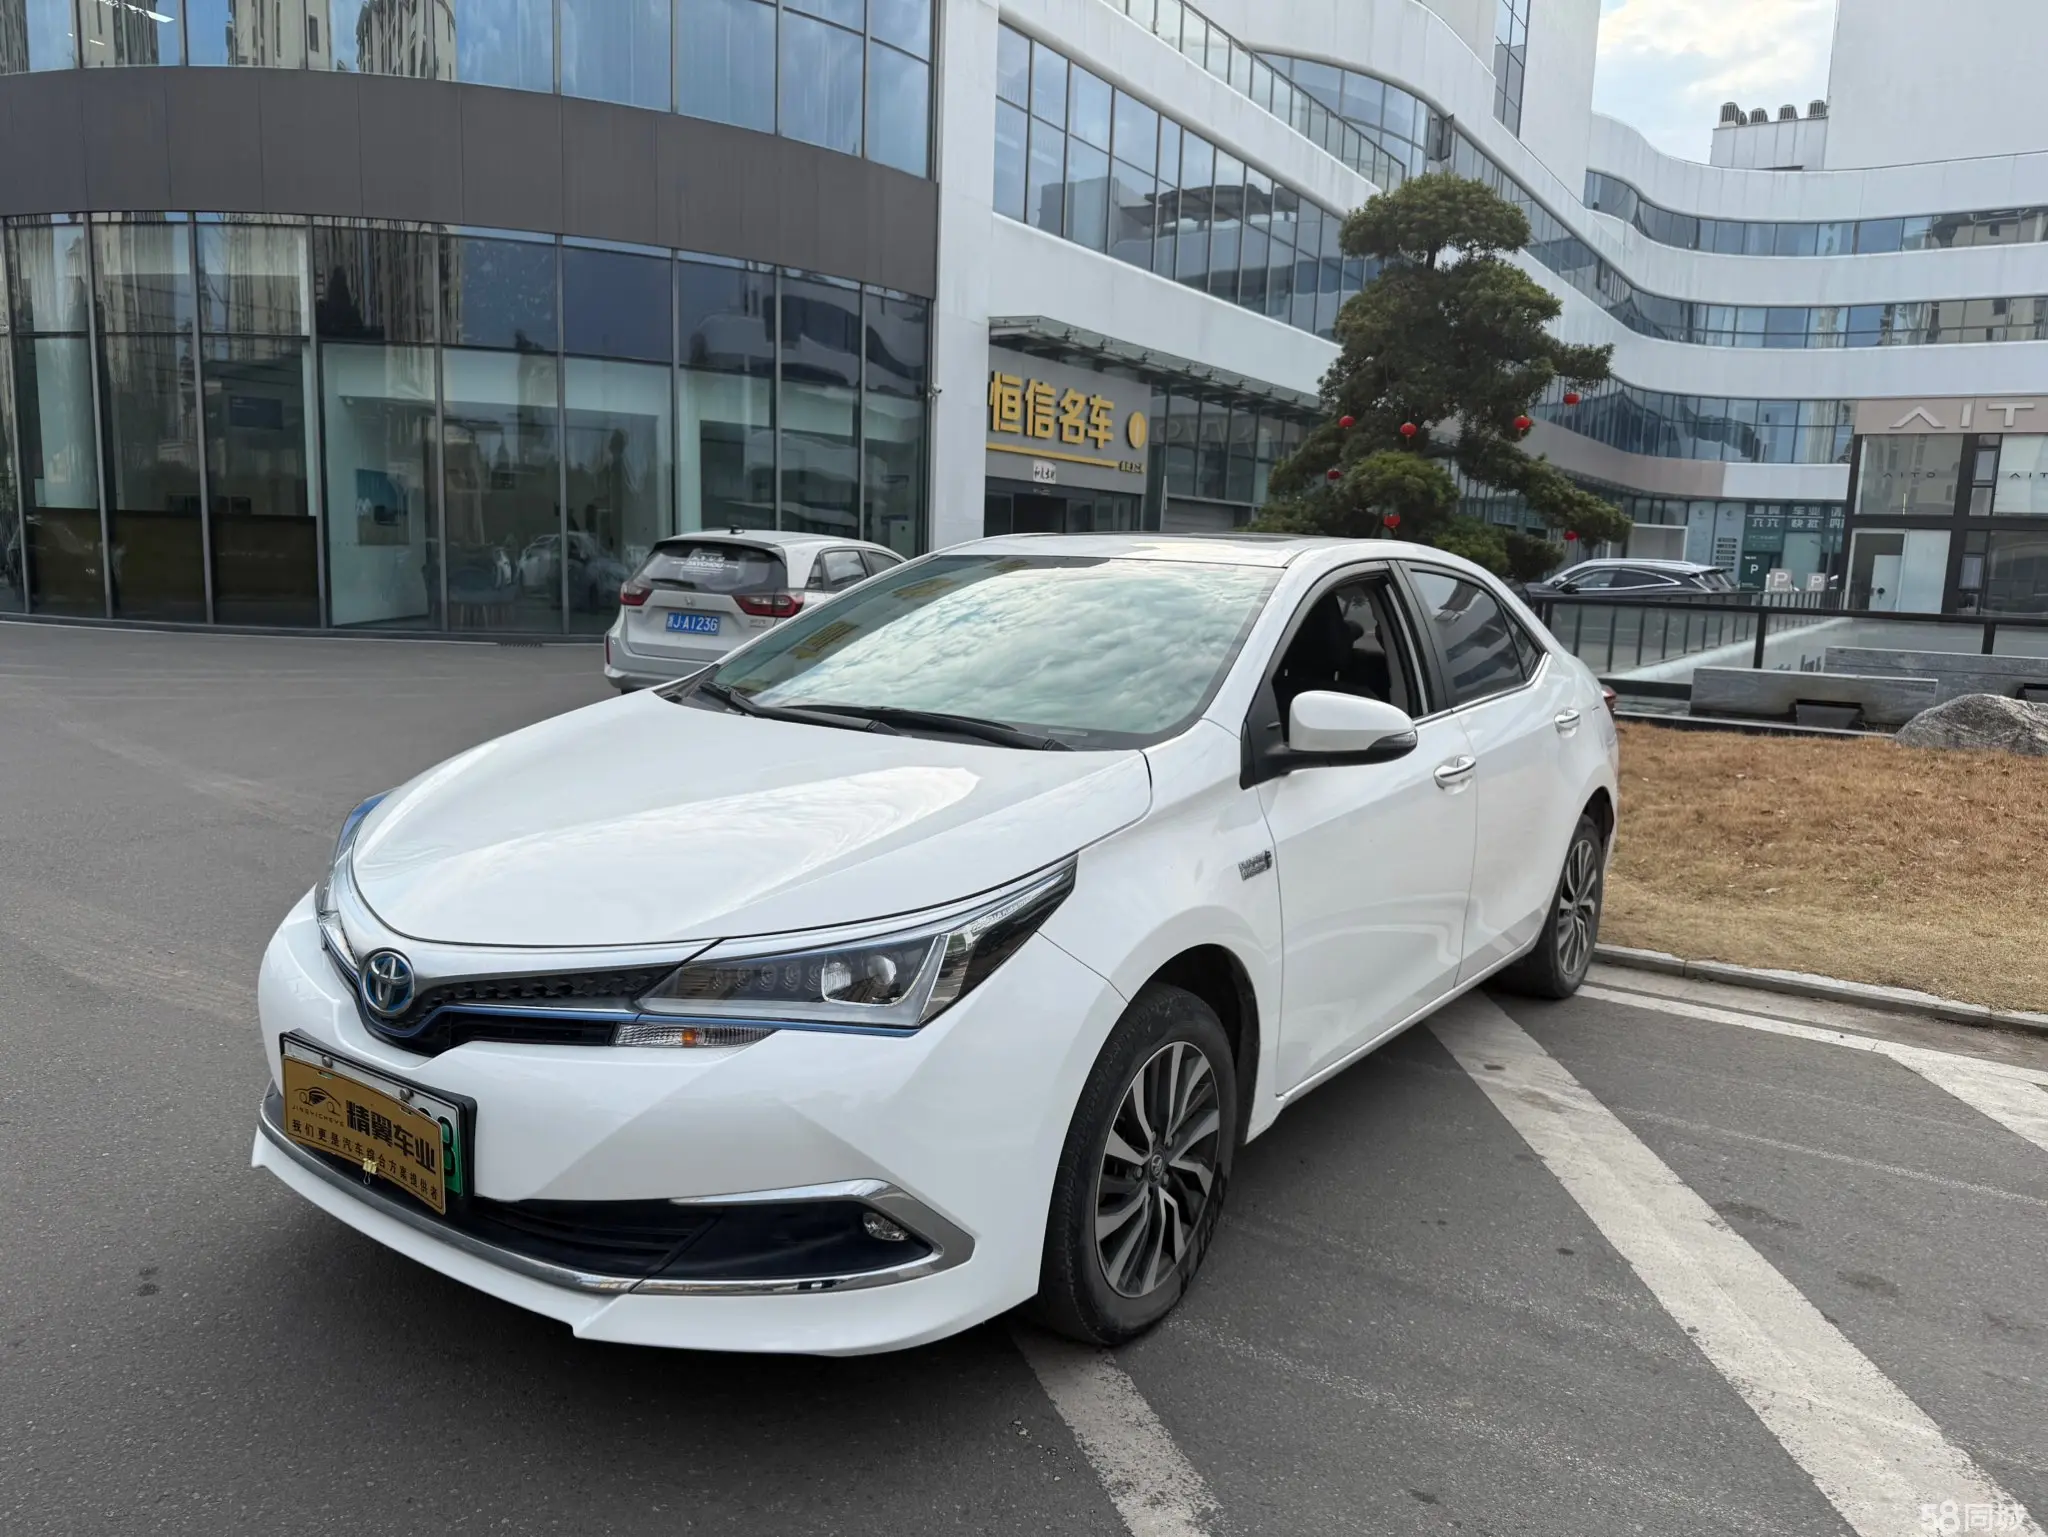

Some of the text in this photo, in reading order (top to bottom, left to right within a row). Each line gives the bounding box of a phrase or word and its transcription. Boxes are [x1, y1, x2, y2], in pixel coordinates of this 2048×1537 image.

[988, 371, 1115, 449] 恒信名车
[346, 1099, 437, 1176] 精翼车业
